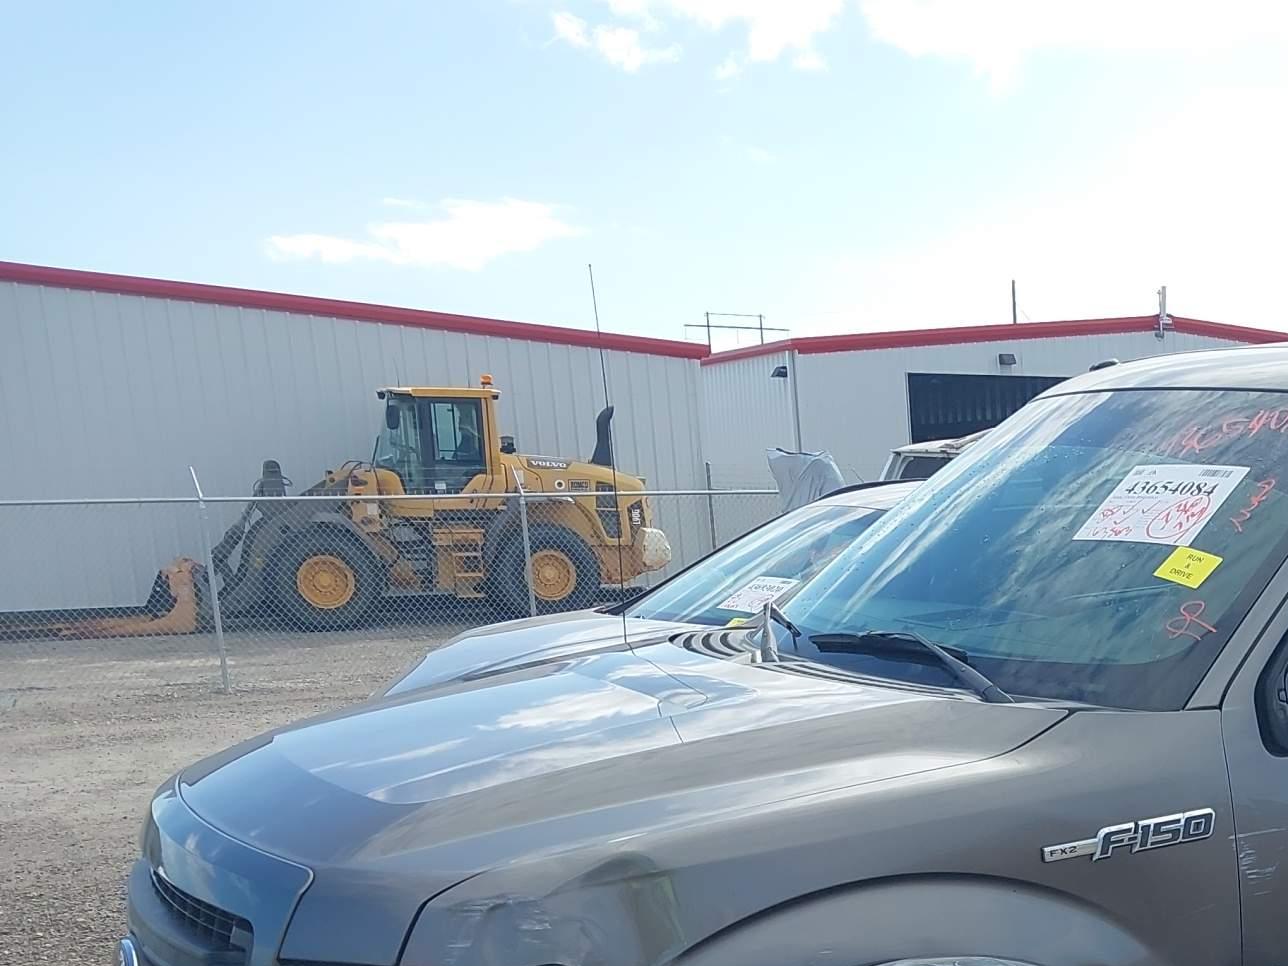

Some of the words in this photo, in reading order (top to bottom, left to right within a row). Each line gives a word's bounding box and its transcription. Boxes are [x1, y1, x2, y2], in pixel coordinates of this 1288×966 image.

[530, 460, 567, 468] VOLVO
[1125, 480, 1219, 497] 43654084
[1186, 553, 1205, 564] RUN
[1169, 567, 1194, 580] DRIVE
[1049, 845, 1078, 857] FX2
